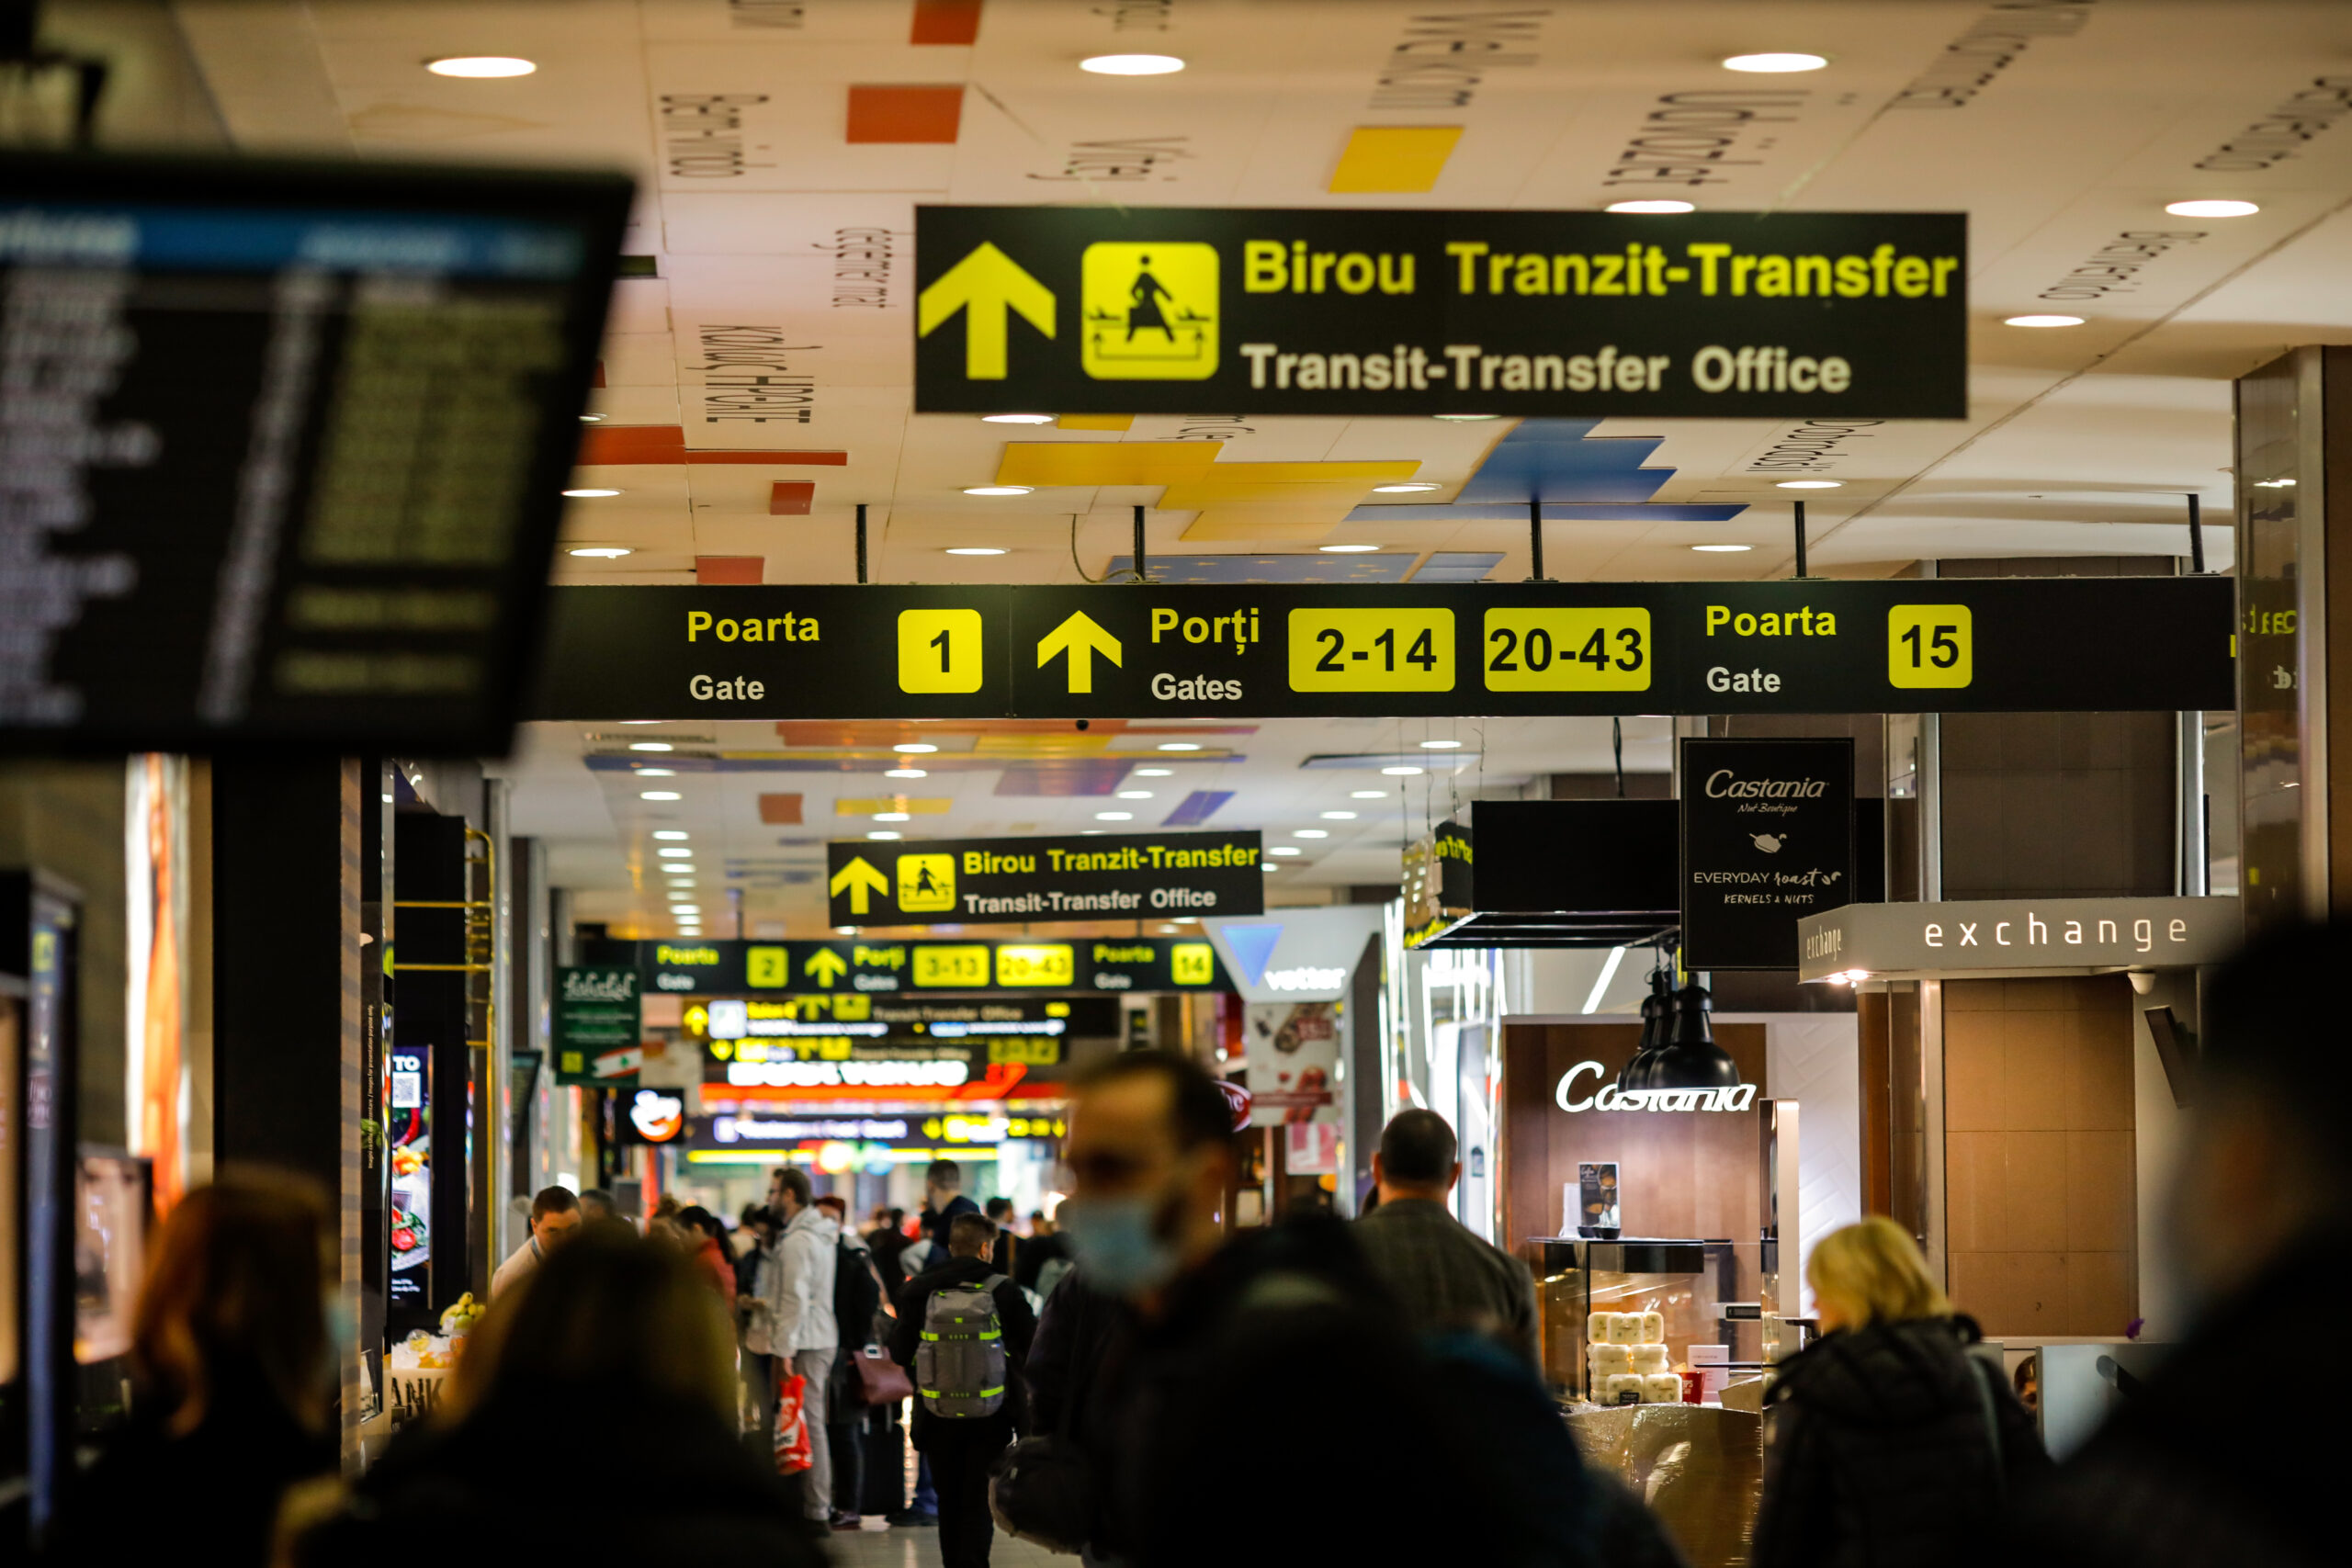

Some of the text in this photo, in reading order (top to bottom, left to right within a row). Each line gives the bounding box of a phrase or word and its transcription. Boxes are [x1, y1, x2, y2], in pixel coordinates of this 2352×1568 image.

[1244, 241, 1958, 299] Birou Tranzit-Transfer
[2038, 231, 2209, 300] Bienvenido
[1240, 344, 1851, 395] Transit-Transfer Office
[687, 611, 951, 673] Poarta 1
[1151, 607, 1644, 672] Porți 2-14 20-43
[1706, 604, 1960, 669] Poarta 15
[689, 674, 765, 701] Gate
[1151, 672, 1243, 701] Gates
[1706, 666, 1781, 694] Gate
[1705, 769, 1827, 798] Castania
[1737, 803, 1798, 817] Nut Boutique
[963, 843, 1259, 874] Birou Tranzit-Transfer
[1693, 868, 1822, 887] EVERYDAY roast
[963, 887, 1217, 915] Transit-Transfer Office
[1724, 894, 1771, 905] KERNELS
[1784, 894, 1815, 905] NUTS
[1806, 925, 1842, 962] exchange
[1925, 912, 2188, 953] exchange
[656, 945, 776, 977] Poarta 2
[926, 956, 978, 976] 3-13
[1092, 944, 1205, 974] Poarta 14
